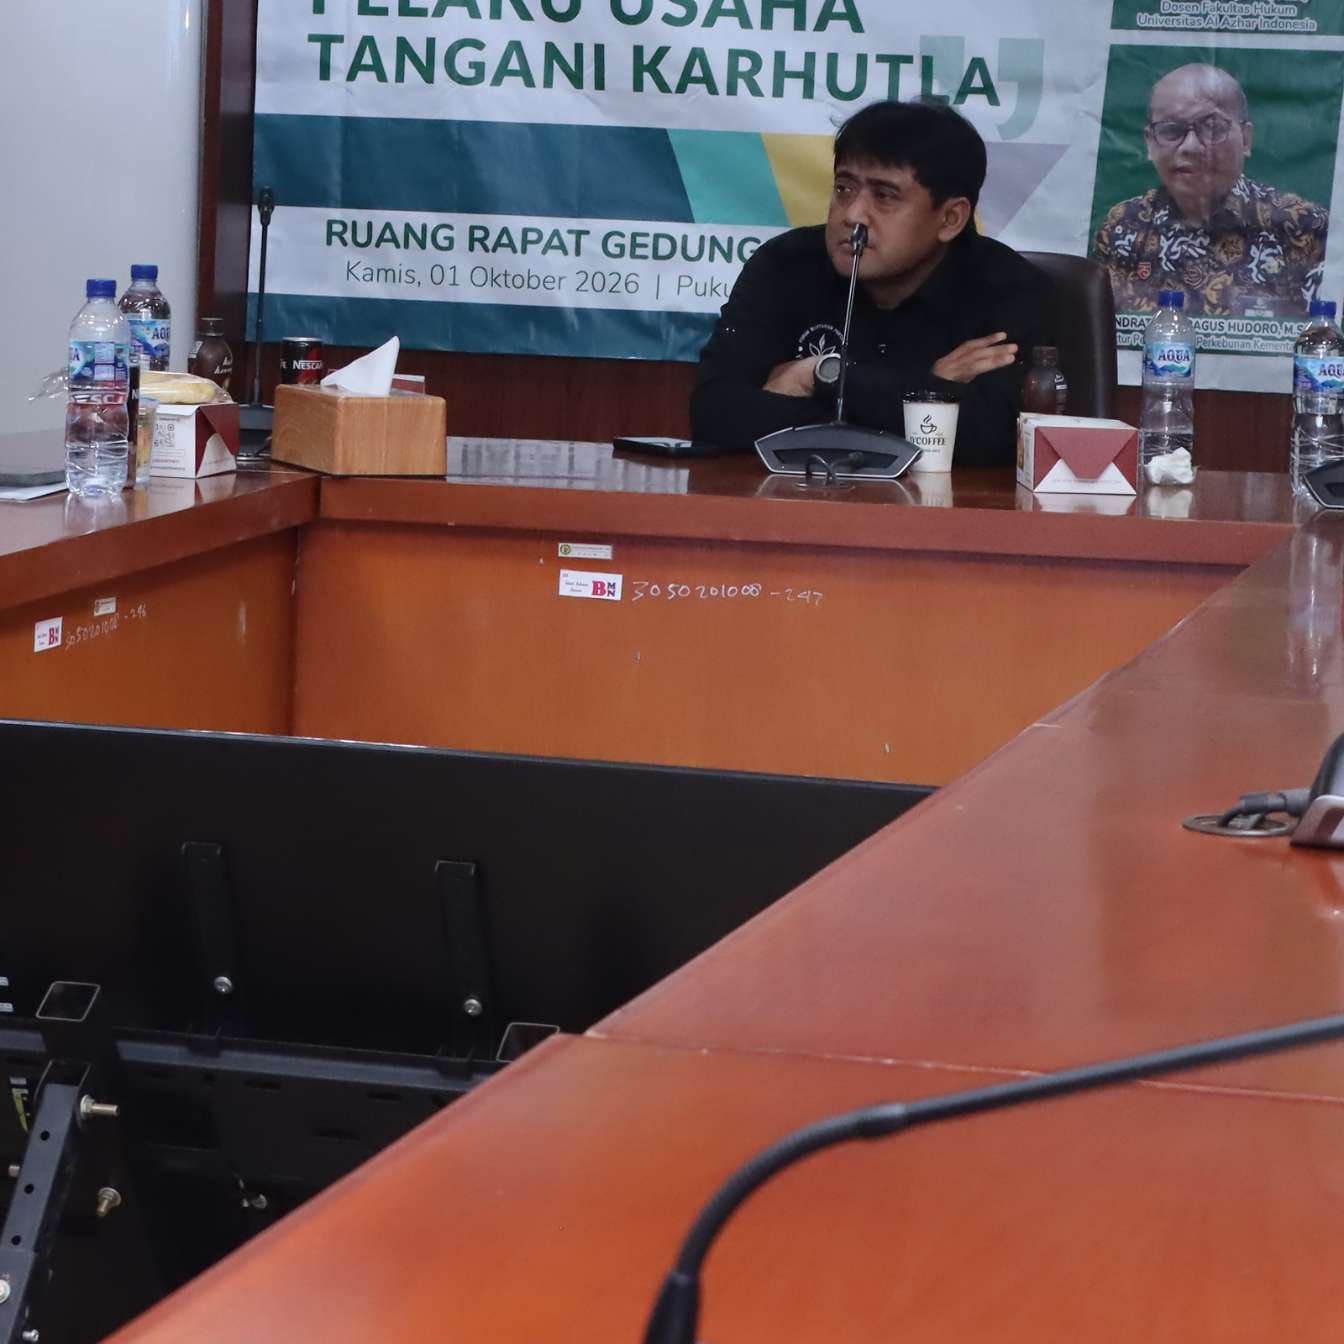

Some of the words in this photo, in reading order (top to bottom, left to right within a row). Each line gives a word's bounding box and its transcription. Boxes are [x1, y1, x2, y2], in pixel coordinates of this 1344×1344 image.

[1161, 0, 1199, 13] Dosen
[1202, 1, 1250, 15] Fakultas
[1254, 2, 1297, 16] Hukum
[1137, 13, 1203, 28] Universitas
[1205, 15, 1219, 28] Al
[1220, 15, 1258, 30] Azhar
[1259, 17, 1317, 31] Indonesia
[308, 34, 605, 90] TANGANI
[633, 42, 1001, 106] KARHUTLA
[326, 219, 455, 251] RUANG
[469, 225, 591, 257] RAPAT
[601, 230, 762, 264] GEDUNG
[345, 260, 422, 288] Kamis,
[429, 265, 459, 287] 01
[469, 265, 567, 291] Oktober
[575, 271, 640, 294] 2026
[1228, 319, 1281, 336] HUDORO,
[1195, 336, 1251, 350] Perkebunan
[1157, 349, 1191, 364] AQUA
